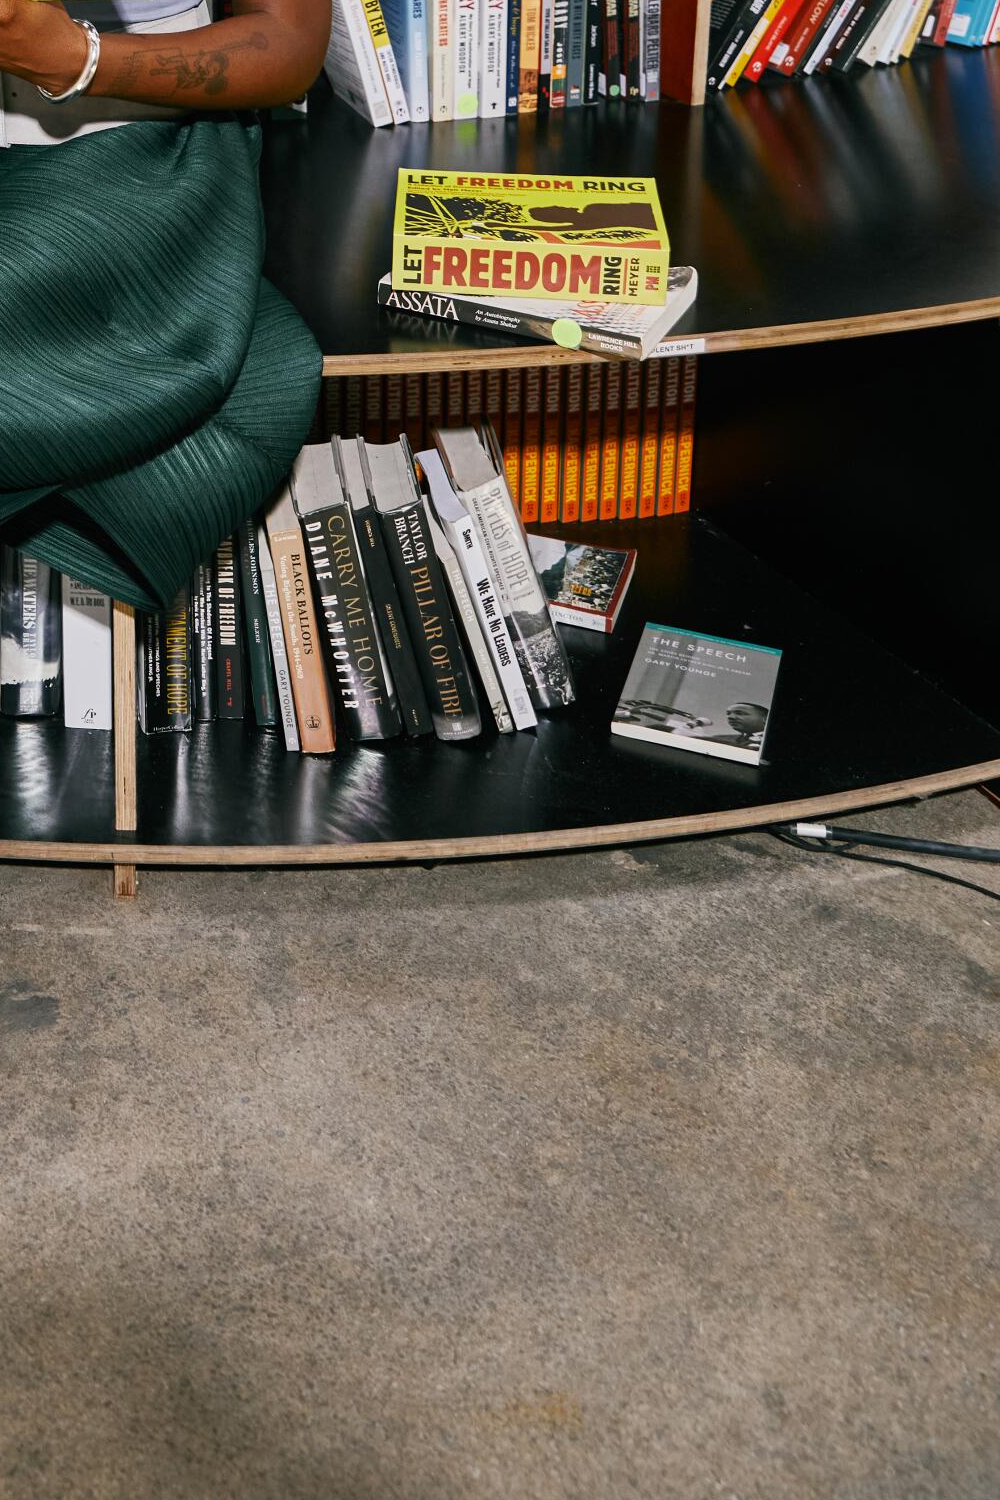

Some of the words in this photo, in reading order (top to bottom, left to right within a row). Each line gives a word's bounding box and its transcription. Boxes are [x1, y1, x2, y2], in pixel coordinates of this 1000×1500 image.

[365, 2, 380, 15] BY
[526, 8, 536, 23] TOM
[554, 1, 568, 29] BABY
[370, 17, 386, 37] TEN
[459, 15, 467, 40] ALBERT
[488, 14, 496, 39] ALBERT
[526, 26, 536, 51] WICKER
[487, 42, 496, 72] WOODFOX
[407, 174, 448, 186] LET
[457, 176, 573, 190] FREEDOM
[583, 181, 646, 192] RING
[403, 244, 422, 284] LET
[423, 246, 603, 294] FREEDOM
[602, 256, 622, 295] RING
[628, 257, 641, 297] MEYER
[386, 290, 460, 321] ASSATA
[486, 311, 521, 324] Autobiography
[587, 333, 623, 347] LAWRENCE
[622, 338, 639, 350] HILL
[600, 342, 623, 352] BOOKS
[394, 516, 416, 566] BRANCH
[407, 510, 428, 560] TAYLOR
[327, 515, 359, 588] CARRY
[250, 555, 261, 595] JOHNSON
[279, 555, 289, 580] Voting
[290, 553, 304, 597] BLACK
[22, 575, 37, 629] WATERS
[218, 588, 235, 598] OF
[263, 582, 277, 605] THE
[282, 581, 292, 603] Rights
[410, 565, 443, 641] PILLAR
[451, 569, 460, 586] THE
[457, 589, 475, 622] SPEECH
[218, 602, 236, 646] FREEDOM
[296, 600, 314, 655] BALLOTS
[305, 521, 333, 581] DIANE
[321, 593, 360, 710] McWHORTER
[343, 598, 367, 629] ME
[268, 608, 285, 658] SPEECH
[428, 644, 452, 669] OF
[651, 636, 680, 648] THE
[687, 644, 747, 663] SPEECH
[166, 664, 188, 679] OF
[278, 669, 287, 692] GARY
[352, 635, 384, 707] HOME
[645, 657, 671, 666] GARY
[675, 663, 717, 678] YOUNGE
[166, 683, 188, 715] HOPE
[281, 693, 294, 729] YOUNGE
[436, 675, 464, 721] FIRE
